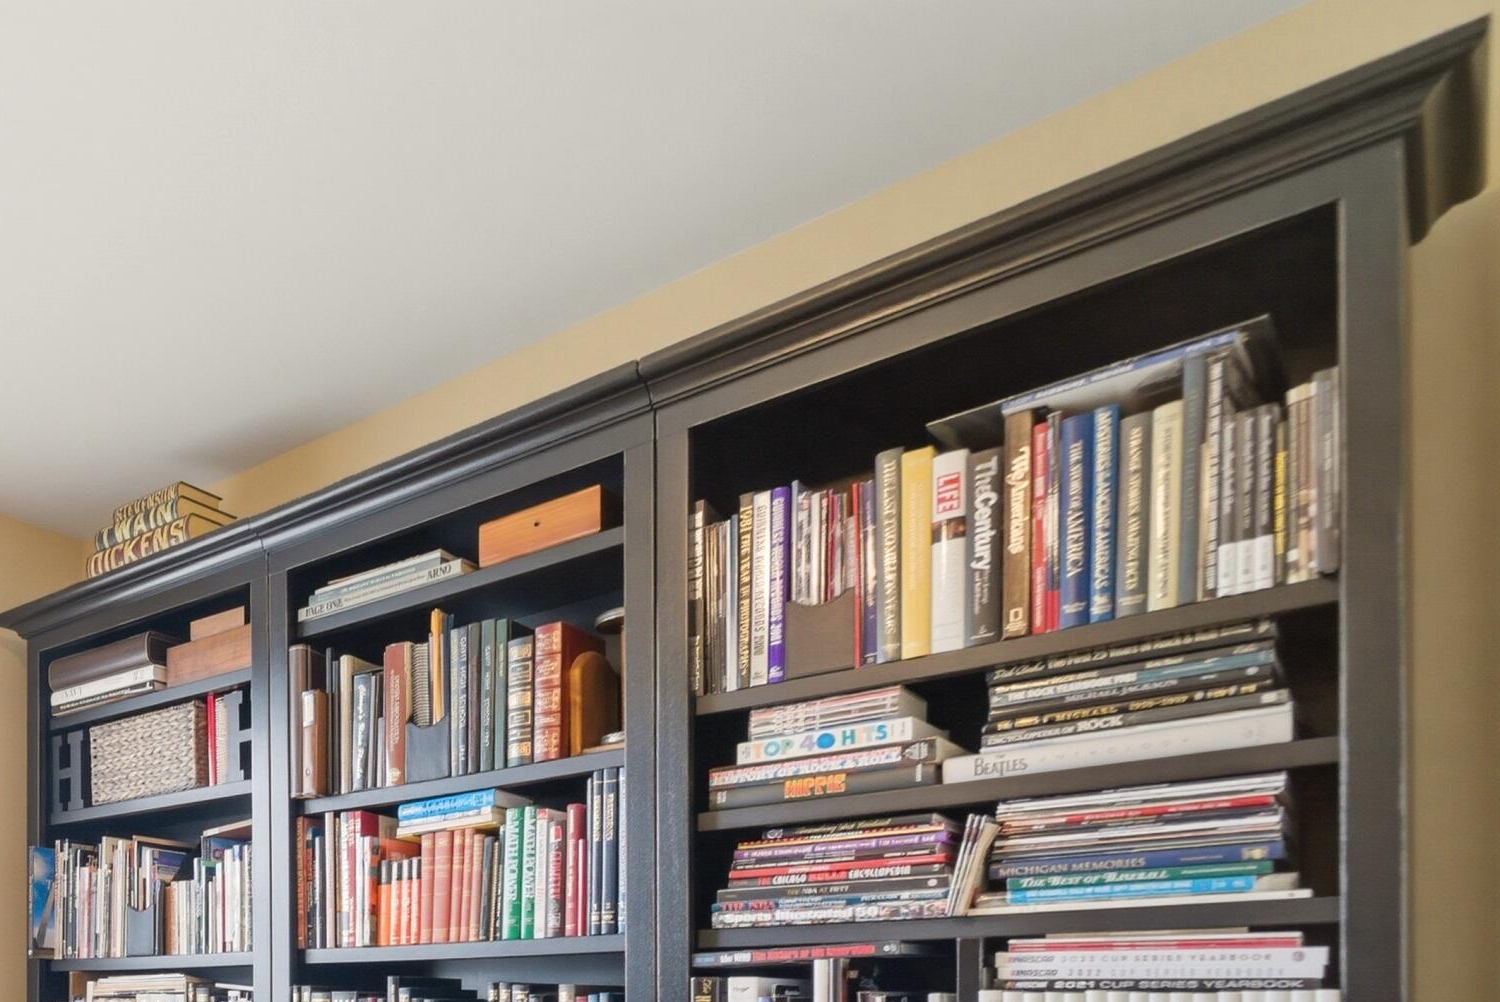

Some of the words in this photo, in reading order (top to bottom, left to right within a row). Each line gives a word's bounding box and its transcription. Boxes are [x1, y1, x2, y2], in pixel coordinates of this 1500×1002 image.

[114, 486, 177, 523] STEVENSON
[937, 472, 960, 513] LIFE
[100, 500, 173, 549] TWAIN
[90, 520, 184, 578] DICKENS
[1066, 509, 1084, 578] AMERICA
[426, 563, 452, 581] ARNO
[1076, 714, 1124, 732] ROCK
[755, 739, 794, 760] TOP
[841, 724, 888, 746] HITS
[974, 757, 1028, 777] BEATLES
[784, 773, 847, 799] HIPPIE
[772, 873, 807, 885] CHICAGO
[848, 864, 912, 880] ENCYCLOPEDIA
[998, 863, 1068, 877] MICHIGAN
[1071, 857, 1146, 873] MEMORIES
[1053, 980, 1096, 989] 2021
[1100, 980, 1135, 989] CUP
[1138, 980, 1197, 989] SERIES
[1203, 980, 1304, 989] YEARBOOK
